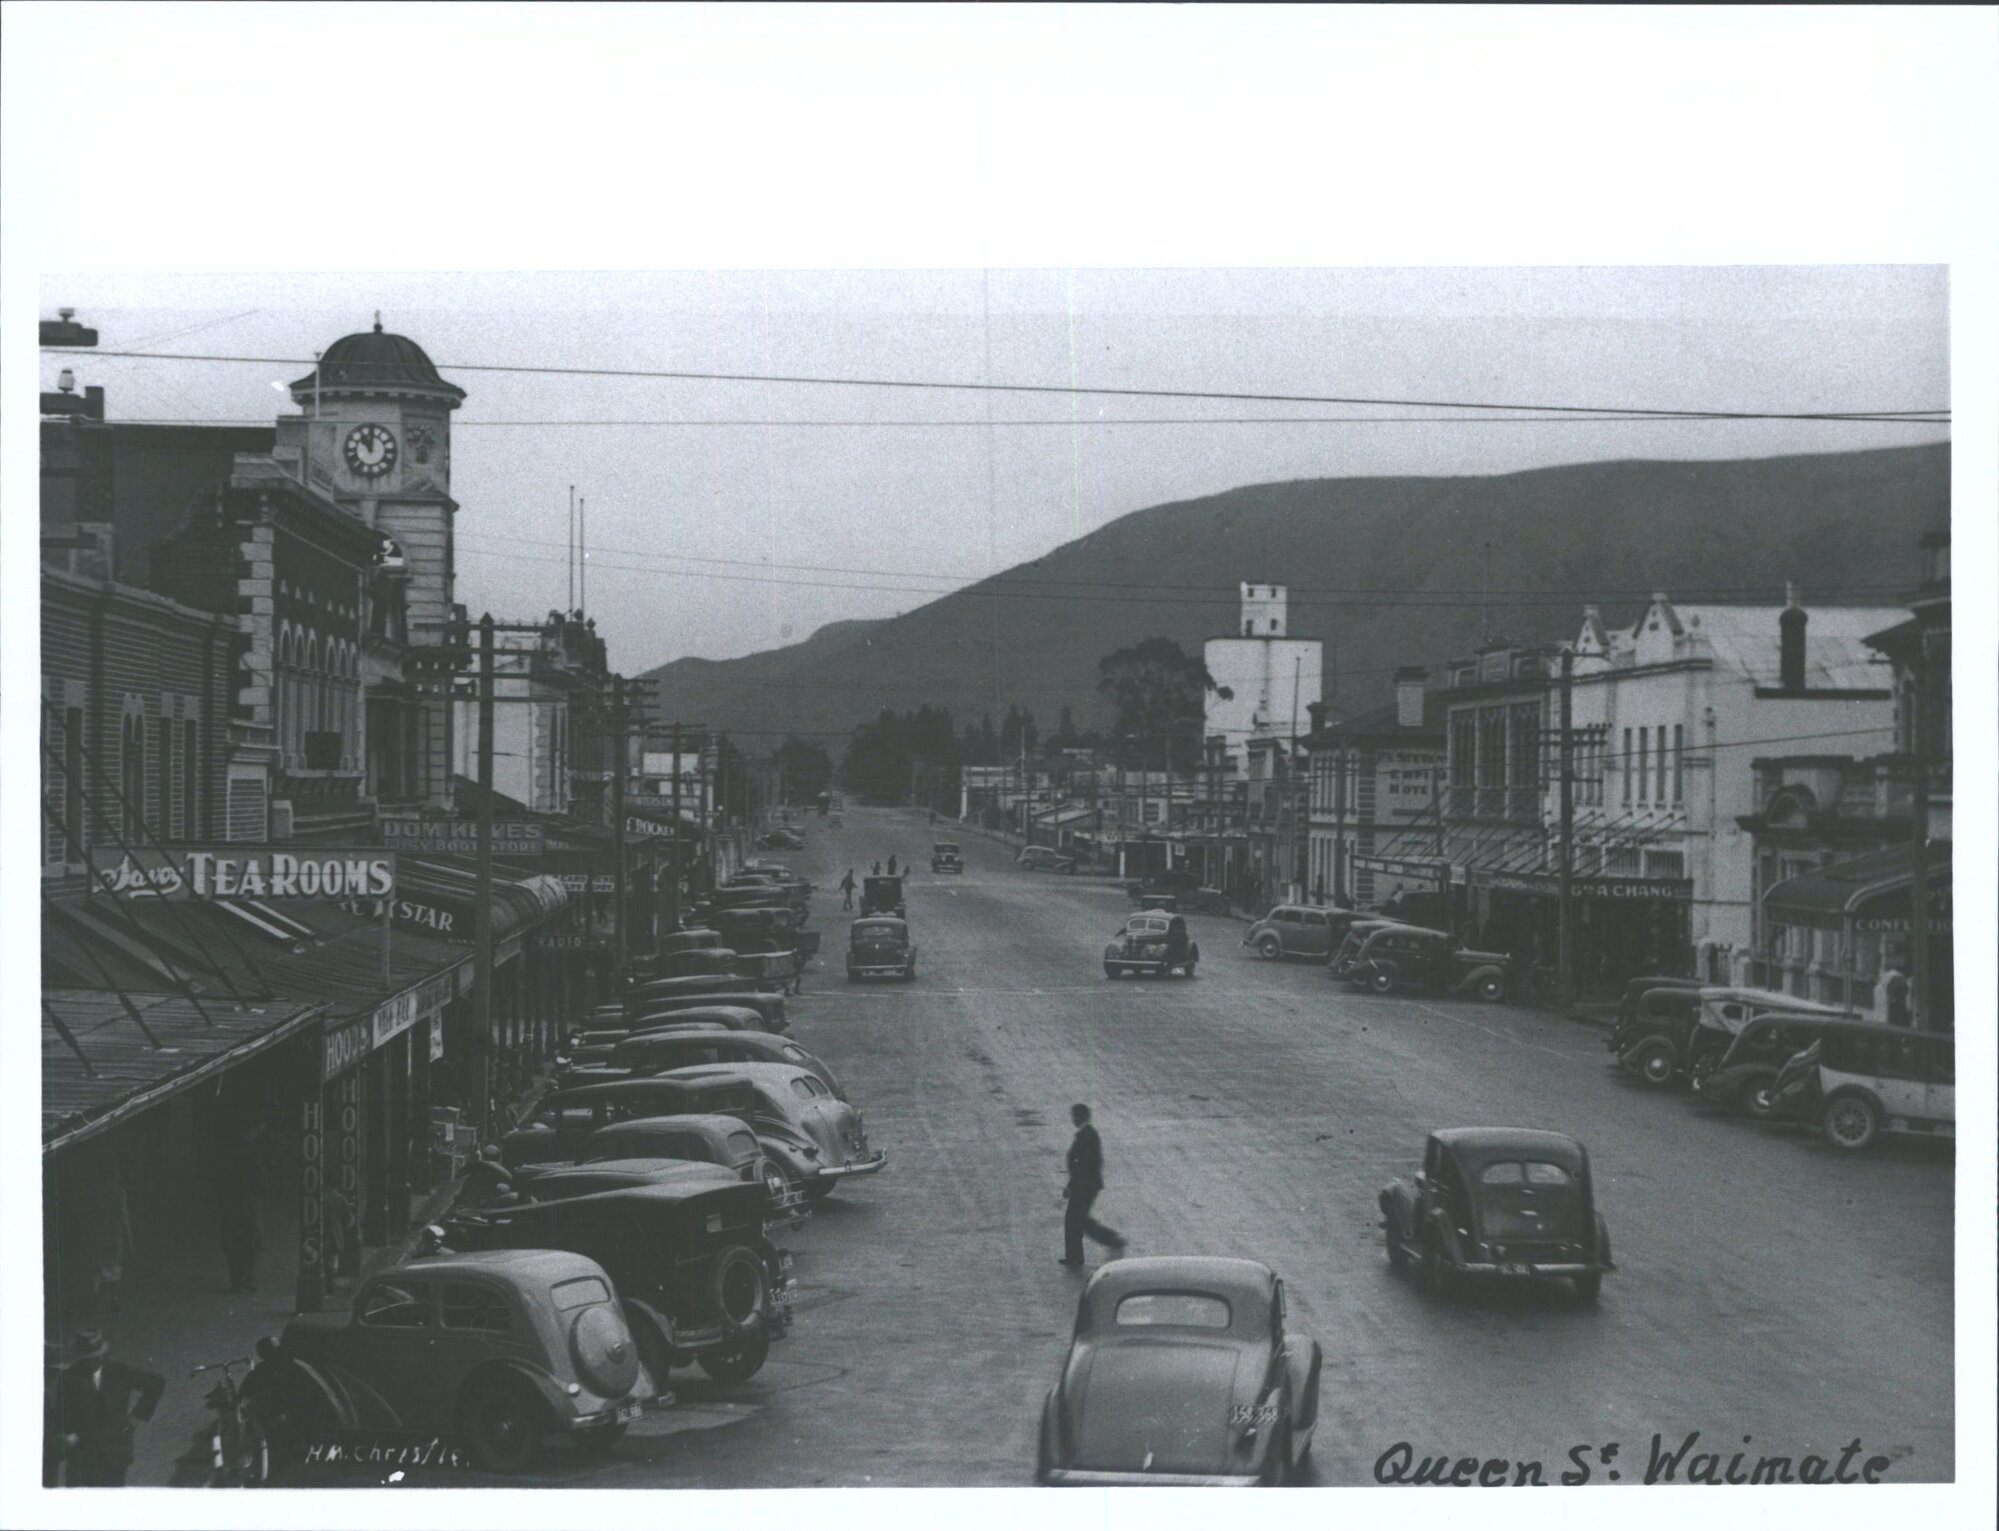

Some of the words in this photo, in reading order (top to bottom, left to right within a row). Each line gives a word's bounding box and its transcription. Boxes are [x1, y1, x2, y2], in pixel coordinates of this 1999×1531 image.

[1389, 784, 1428, 795] HOTE
[384, 821, 441, 837] DOM
[93, 854, 184, 898] Savoy
[185, 852, 266, 896] TEA
[269, 853, 392, 896] ROOMS
[1612, 885, 1673, 898] CHANG
[399, 901, 454, 932] STAR
[302, 1102, 320, 1265] HOODS
